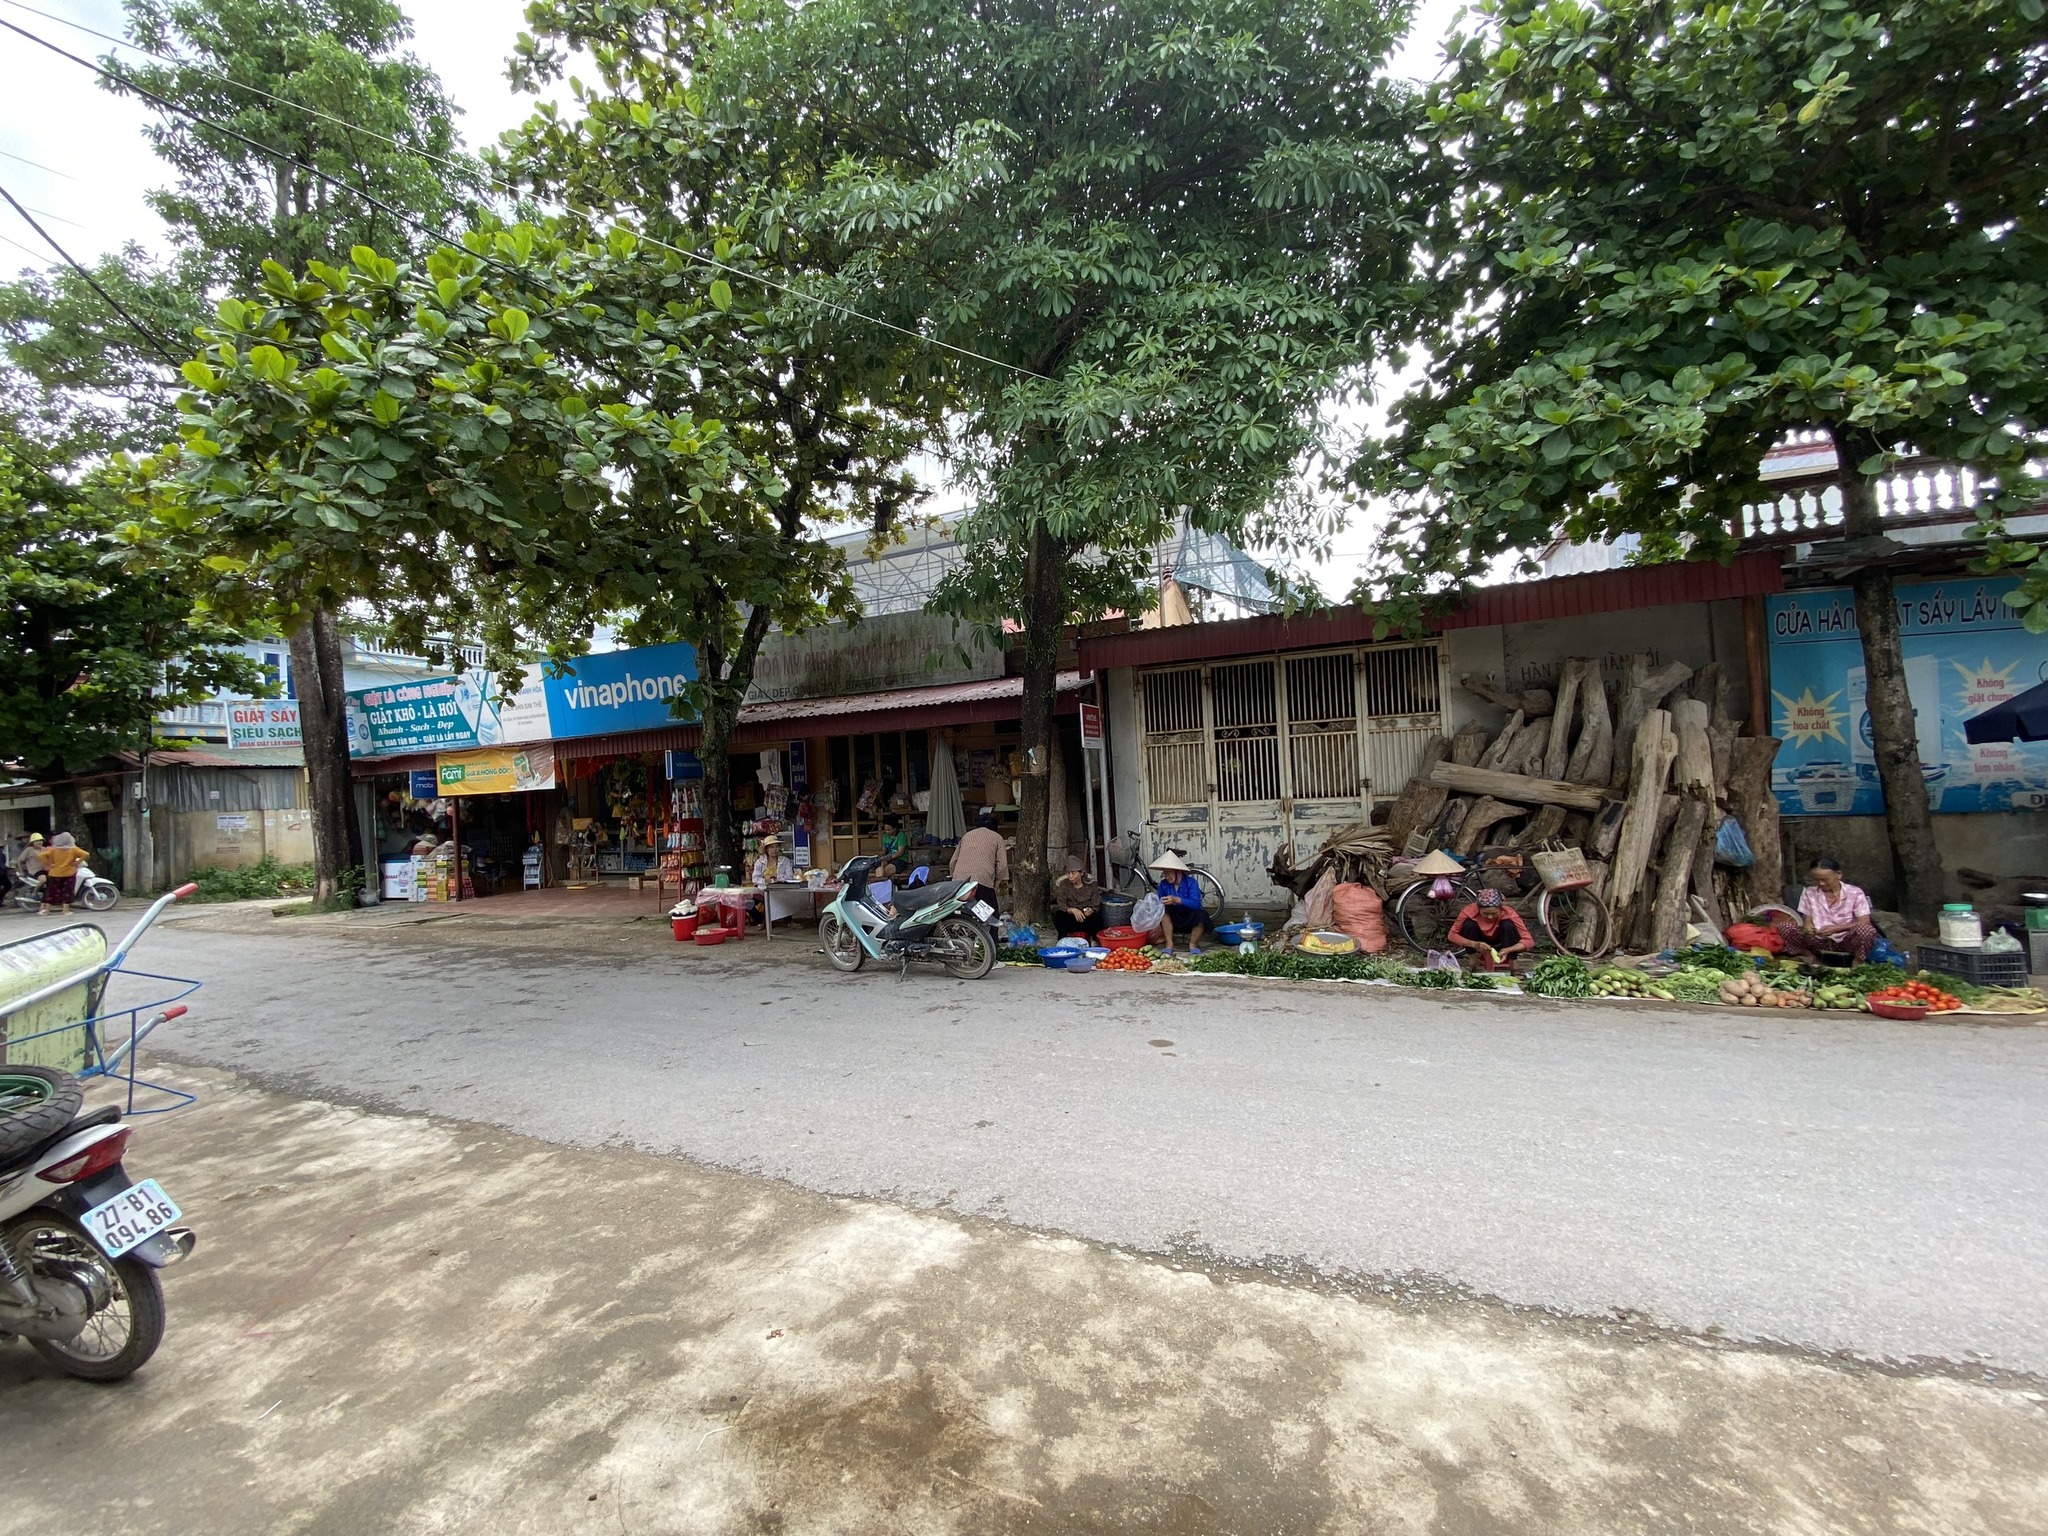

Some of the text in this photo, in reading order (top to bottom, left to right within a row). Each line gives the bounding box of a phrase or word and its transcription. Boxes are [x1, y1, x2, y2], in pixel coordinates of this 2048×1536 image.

[1775, 602, 1813, 637] CỬA
[1818, 602, 1859, 632] HÀN
[1918, 589, 1956, 626] SẤY
[1960, 585, 1997, 623] LẤY
[383, 688, 396, 703] LÀ
[564, 673, 687, 710] vinaphone
[233, 705, 297, 726] GIẶT SẤY
[370, 699, 459, 727] GIẶT KHÔ LÀ HƠI
[1797, 706, 1825, 719] Không
[268, 727, 302, 739] SẠCH
[378, 721, 454, 736] Nhanh Sạch Đẹp
[95, 1188, 154, 1230] 27-B1
[105, 1202, 173, 1249] 094.86
